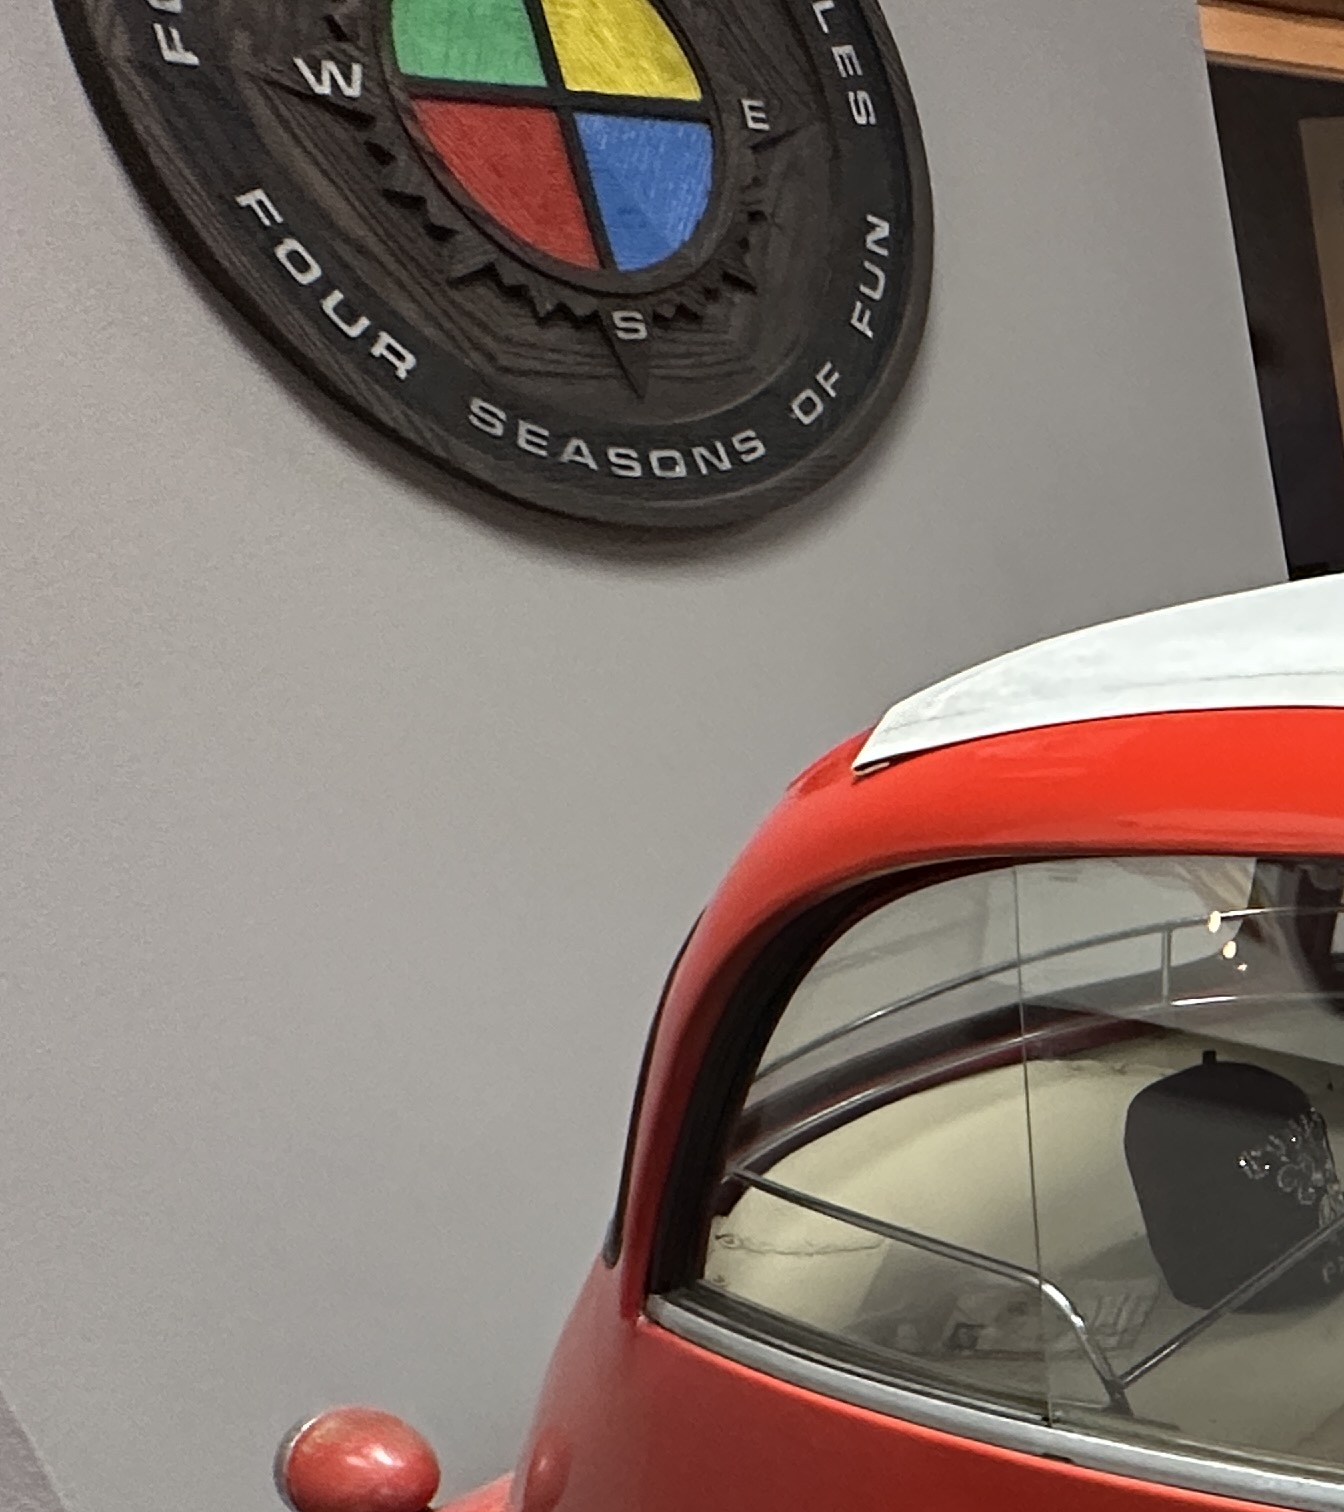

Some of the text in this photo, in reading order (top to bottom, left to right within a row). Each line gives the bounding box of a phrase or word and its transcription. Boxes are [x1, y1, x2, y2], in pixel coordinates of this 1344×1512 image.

[292, 57, 364, 98] W
[740, 98, 770, 131] E
[235, 187, 891, 479] FOUR SEASONS OF FUN
[611, 310, 648, 340] S
